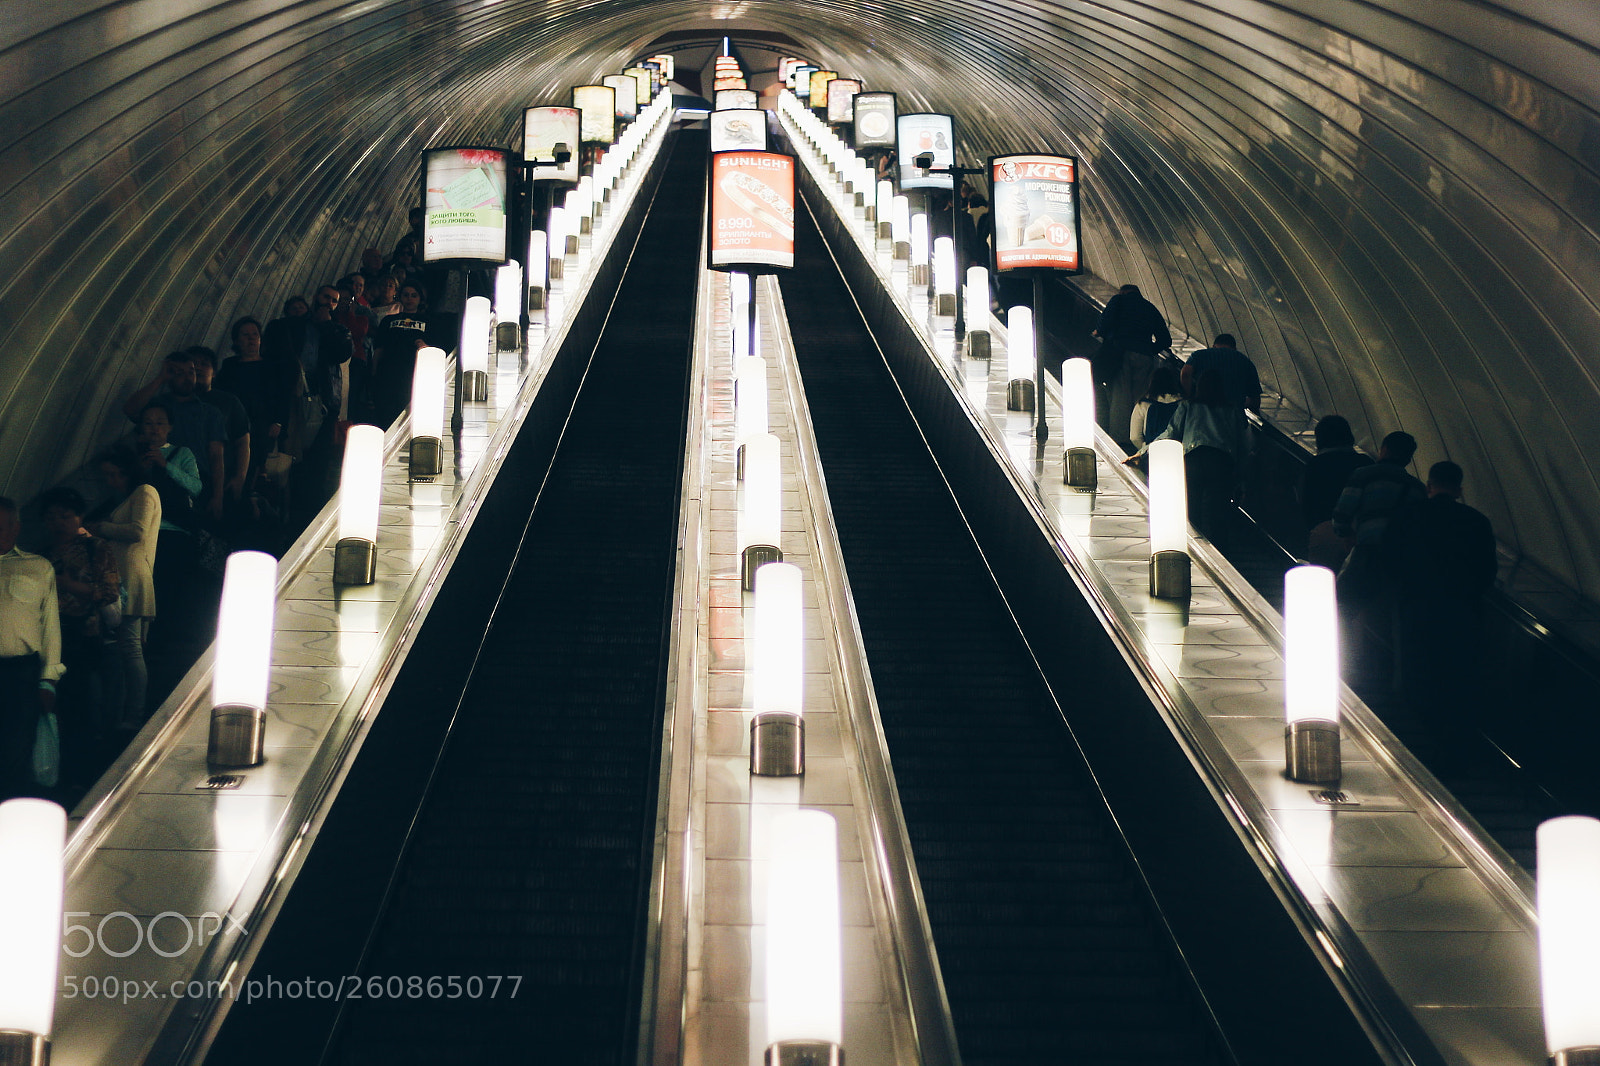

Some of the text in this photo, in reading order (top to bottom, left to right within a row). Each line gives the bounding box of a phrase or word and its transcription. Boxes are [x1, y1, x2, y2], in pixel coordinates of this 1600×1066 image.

[719, 157, 790, 170] SUNLIGHT
[1024, 163, 1070, 180] KFC
[1025, 182, 1071, 193] МОРОЖЕНОЕ
[1044, 192, 1071, 203] РОЖОК
[719, 230, 772, 239] БРИЛЛИАНТЫ
[719, 238, 751, 246] ЗОЛОТО
